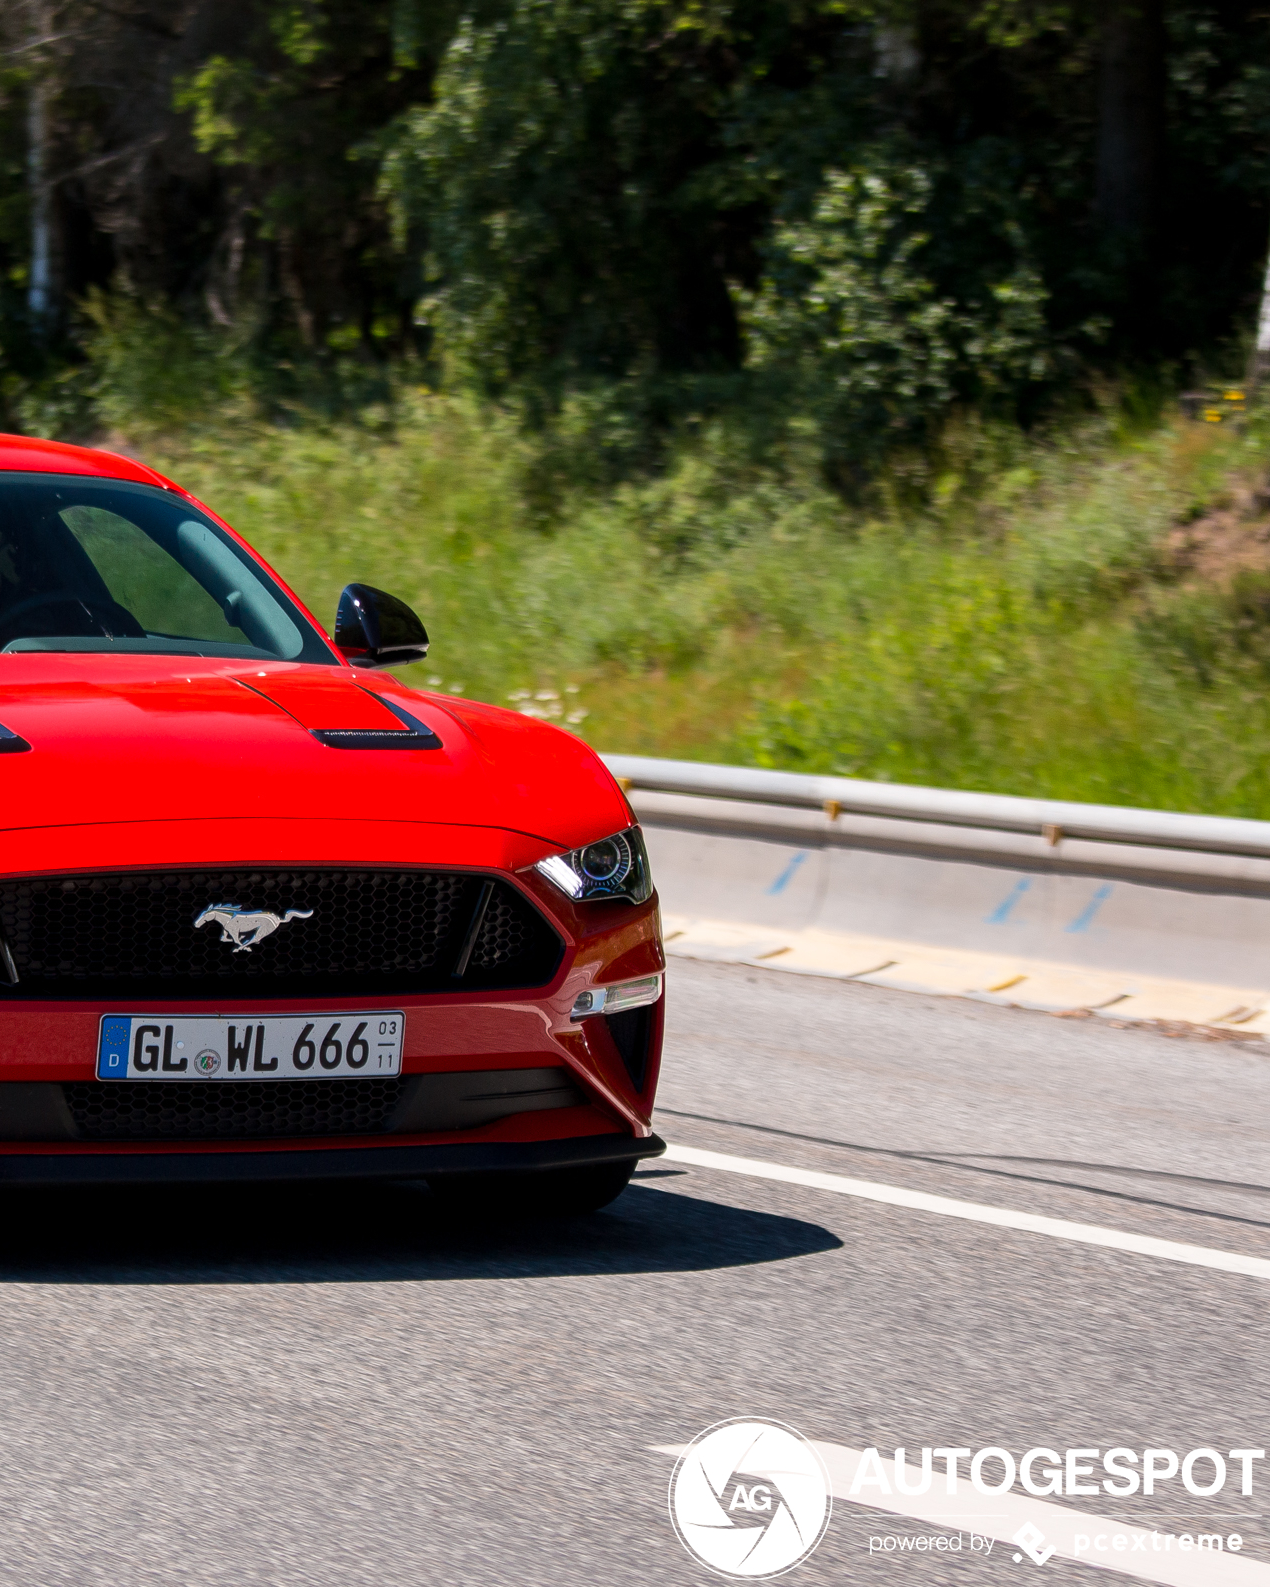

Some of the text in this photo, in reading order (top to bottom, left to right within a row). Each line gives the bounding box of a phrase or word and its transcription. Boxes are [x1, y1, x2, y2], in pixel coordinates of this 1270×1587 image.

[379, 1021, 397, 1035] 03
[133, 1025, 188, 1072] GL
[228, 1024, 279, 1072] WL
[292, 1022, 369, 1071] 666
[108, 1053, 120, 1067] D
[378, 1054, 393, 1068] 11
